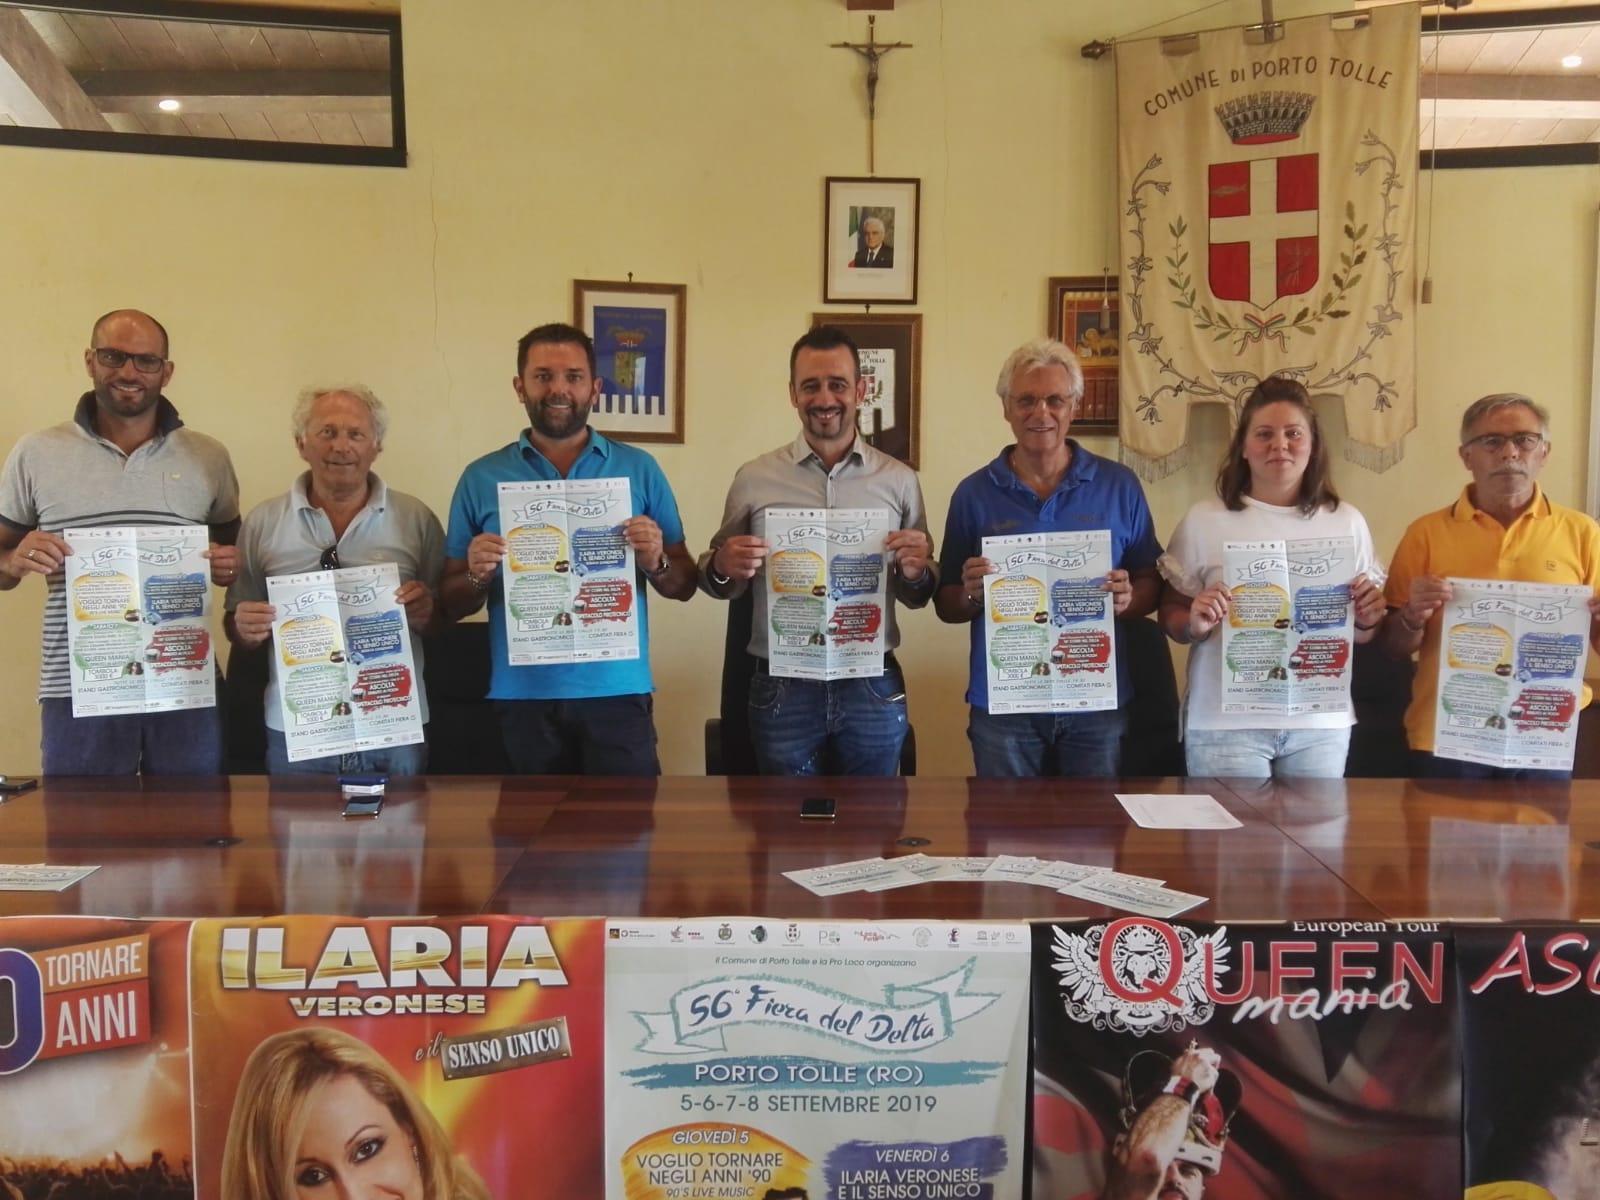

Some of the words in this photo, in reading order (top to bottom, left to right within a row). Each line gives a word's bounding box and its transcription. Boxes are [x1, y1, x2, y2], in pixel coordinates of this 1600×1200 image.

[1144, 69, 1220, 116] COMUNE
[1231, 69, 1246, 83] DI
[1253, 55, 1317, 80] PORTO
[1329, 57, 1393, 89] TOLLE
[1294, 921, 1387, 937] European
[46, 942, 142, 987] TORNARE
[222, 925, 568, 990] ILARIA
[721, 957, 758, 965] Comune
[759, 957, 768, 965] di
[769, 957, 789, 965] Porto
[791, 957, 811, 965] Tolle
[829, 958, 843, 966] Pro
[866, 959, 917, 968] organizzano
[1099, 916, 1444, 1008] QUEEN
[289, 994, 486, 1017] VERONESE
[1232, 977, 1413, 1025] mania
[56, 991, 137, 1048] ANNI
[746, 984, 809, 1023] Fiera
[819, 1002, 863, 1036] del
[864, 1011, 935, 1045] Delta
[449, 1038, 503, 1068] SENSO
[506, 1026, 560, 1058] UNICO
[695, 1063, 779, 1084] PORTO
[786, 1064, 857, 1084] TOLLE
[866, 1065, 924, 1086] (RO)
[680, 1094, 759, 1112] 5-6-7-8
[767, 1095, 880, 1113] SETTEMBRE
[887, 1096, 938, 1113] 2019
[672, 1128, 736, 1145] GIOVEDÌ
[739, 1131, 749, 1144] 5
[636, 1153, 704, 1169] VOGLIO
[708, 1152, 783, 1167] TORNARE
[876, 1147, 938, 1163] VENERDÌ
[941, 1151, 950, 1162] 6
[649, 1170, 696, 1185] NEGLI
[701, 1169, 742, 1184] ANNI
[841, 1170, 890, 1185] ILARIA
[896, 1168, 979, 1184] VERONESE
[692, 1187, 714, 1198] LIVE
[718, 1187, 755, 1198] MUSIC
[838, 1186, 847, 1200] E
[852, 1186, 864, 1200] IL
[868, 1184, 921, 1199] SENSO
[926, 1183, 981, 1199] UNICO
